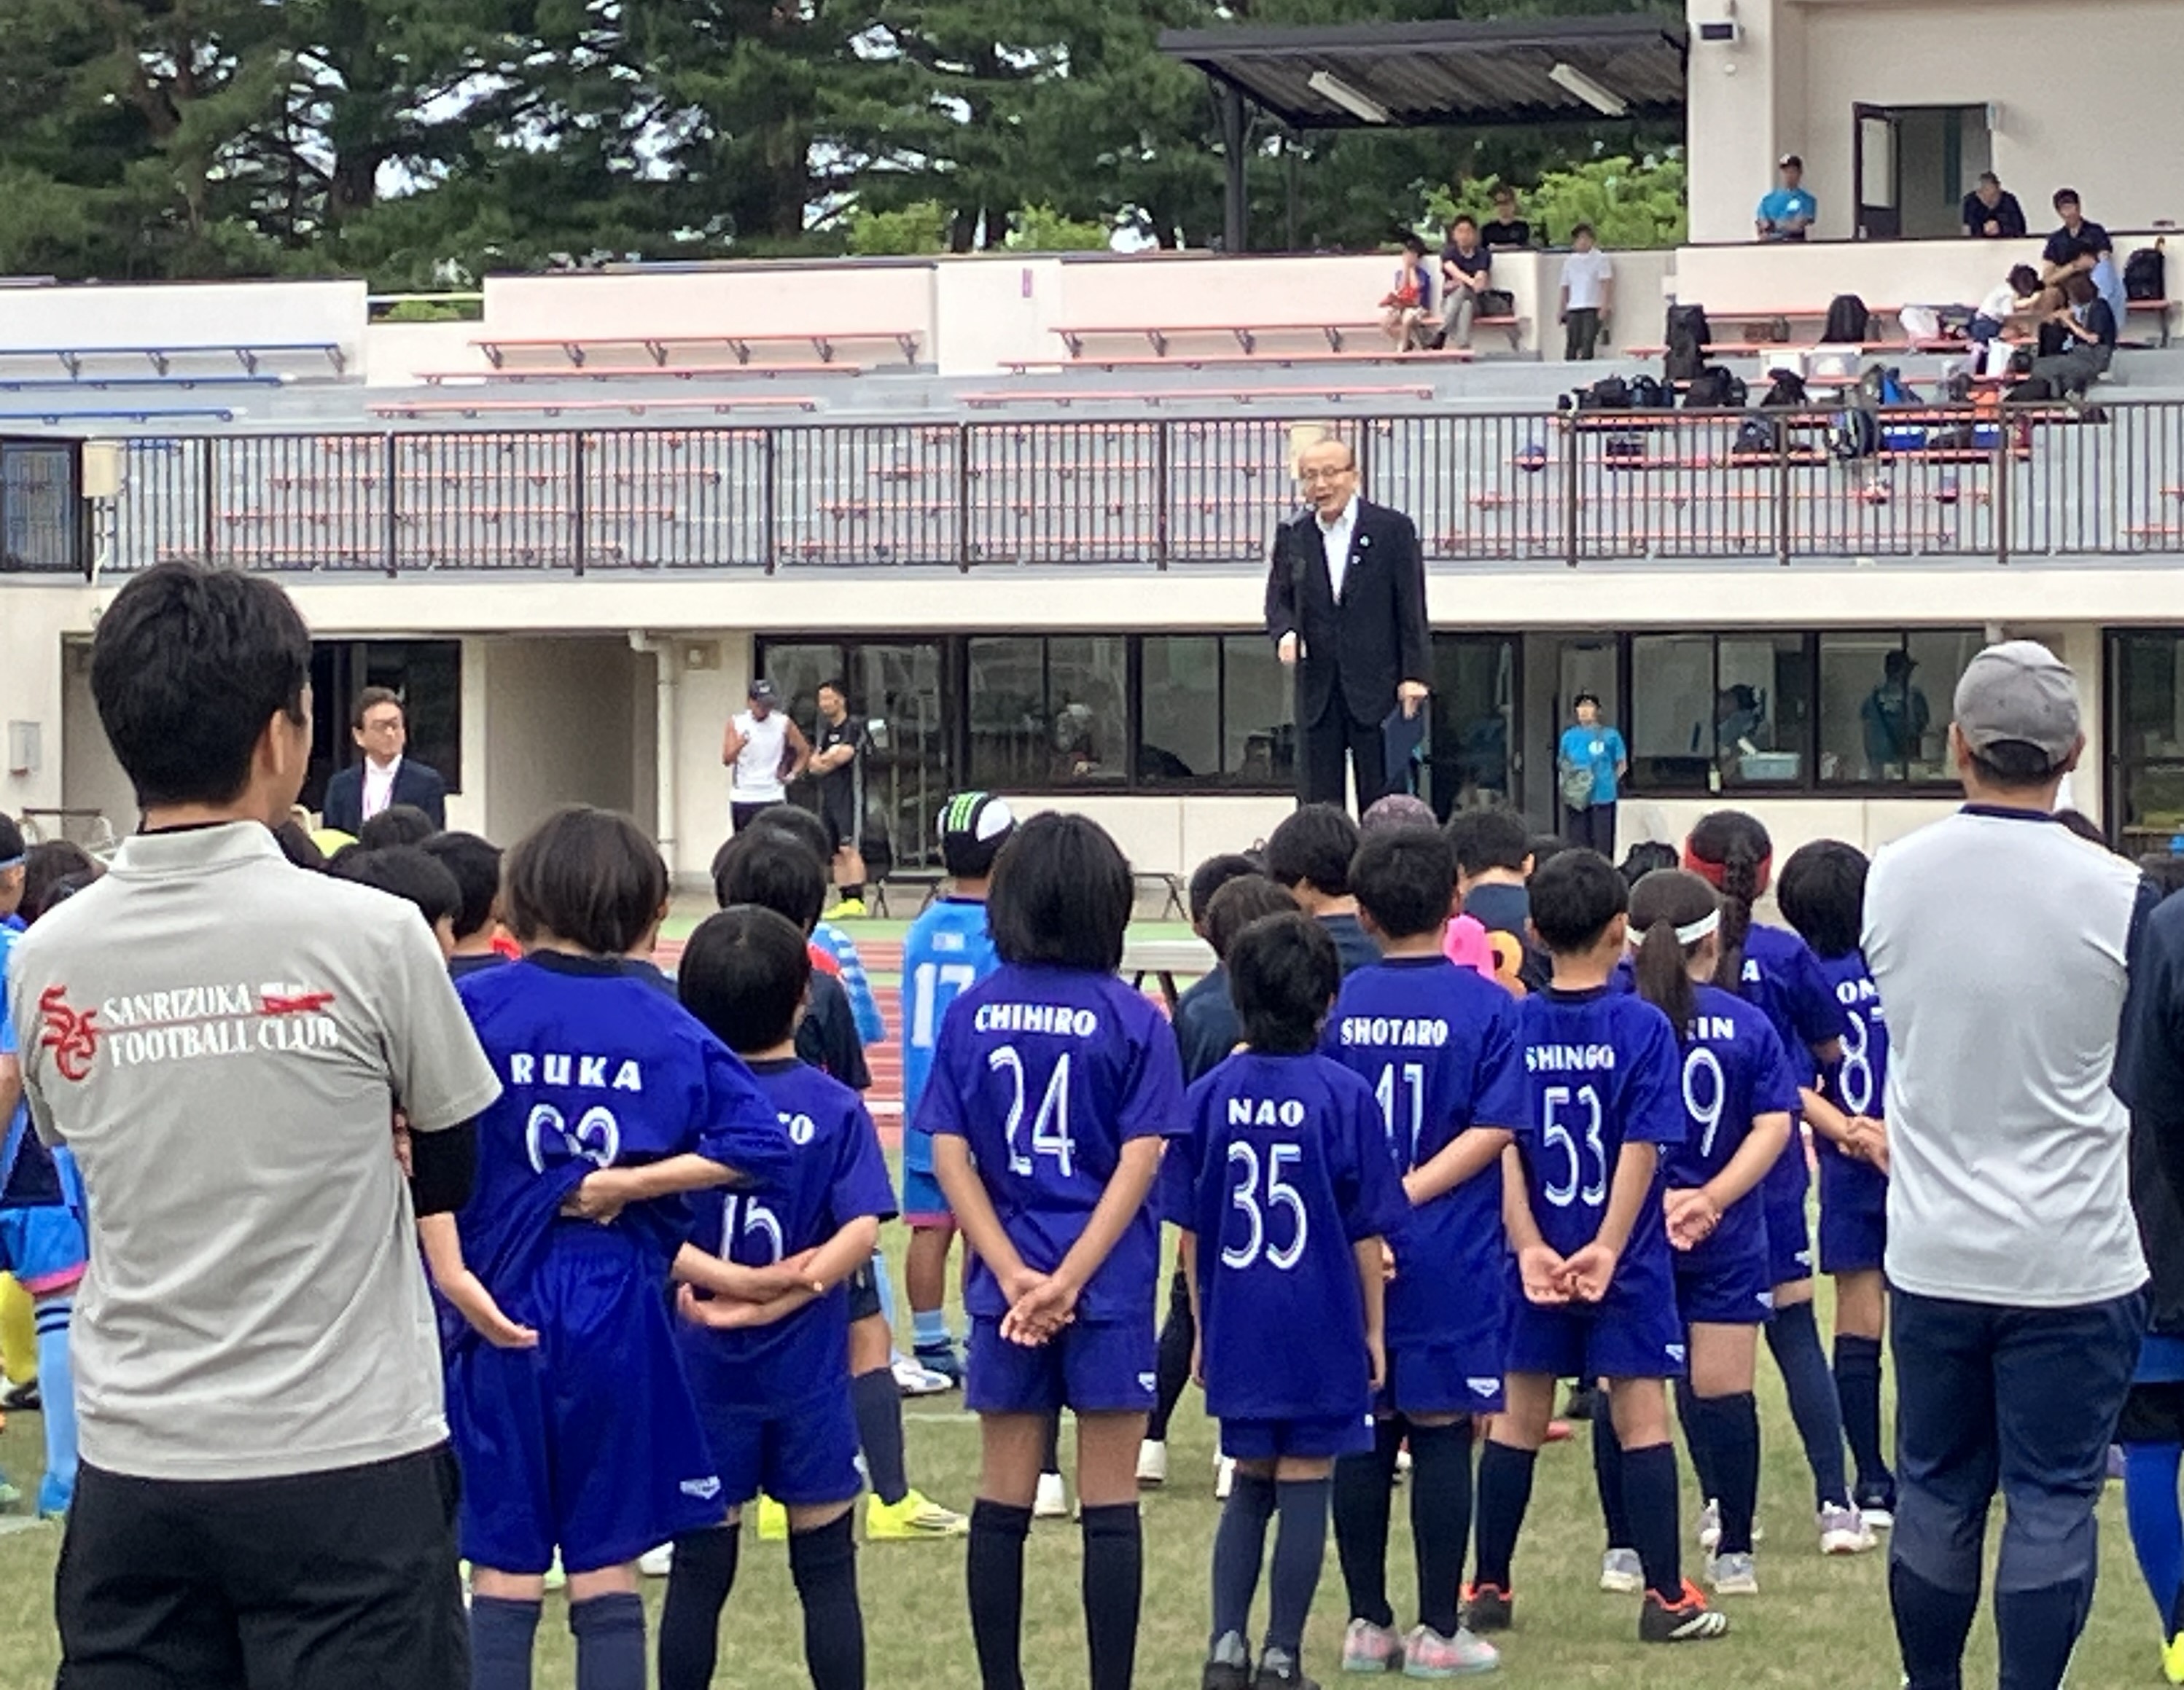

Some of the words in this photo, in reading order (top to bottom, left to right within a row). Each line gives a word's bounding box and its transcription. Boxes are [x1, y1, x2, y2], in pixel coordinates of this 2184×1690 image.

[104, 982, 251, 1026] SANRIZUKA
[975, 1003, 1098, 1038] CHIHIRO
[109, 1019, 257, 1068] FOOTBALL
[1340, 1017, 1449, 1048] SHOTARO
[1686, 1017, 1734, 1041] IN
[510, 1052, 641, 1091] RUKA
[1525, 1044, 1615, 1072] SHINGO
[988, 1044, 1076, 1178] 24
[1228, 1098, 1305, 1127] NAO
[1682, 1047, 1725, 1158] 9
[1543, 1083, 1607, 1207] 53
[1221, 1140, 1308, 1270] 35
